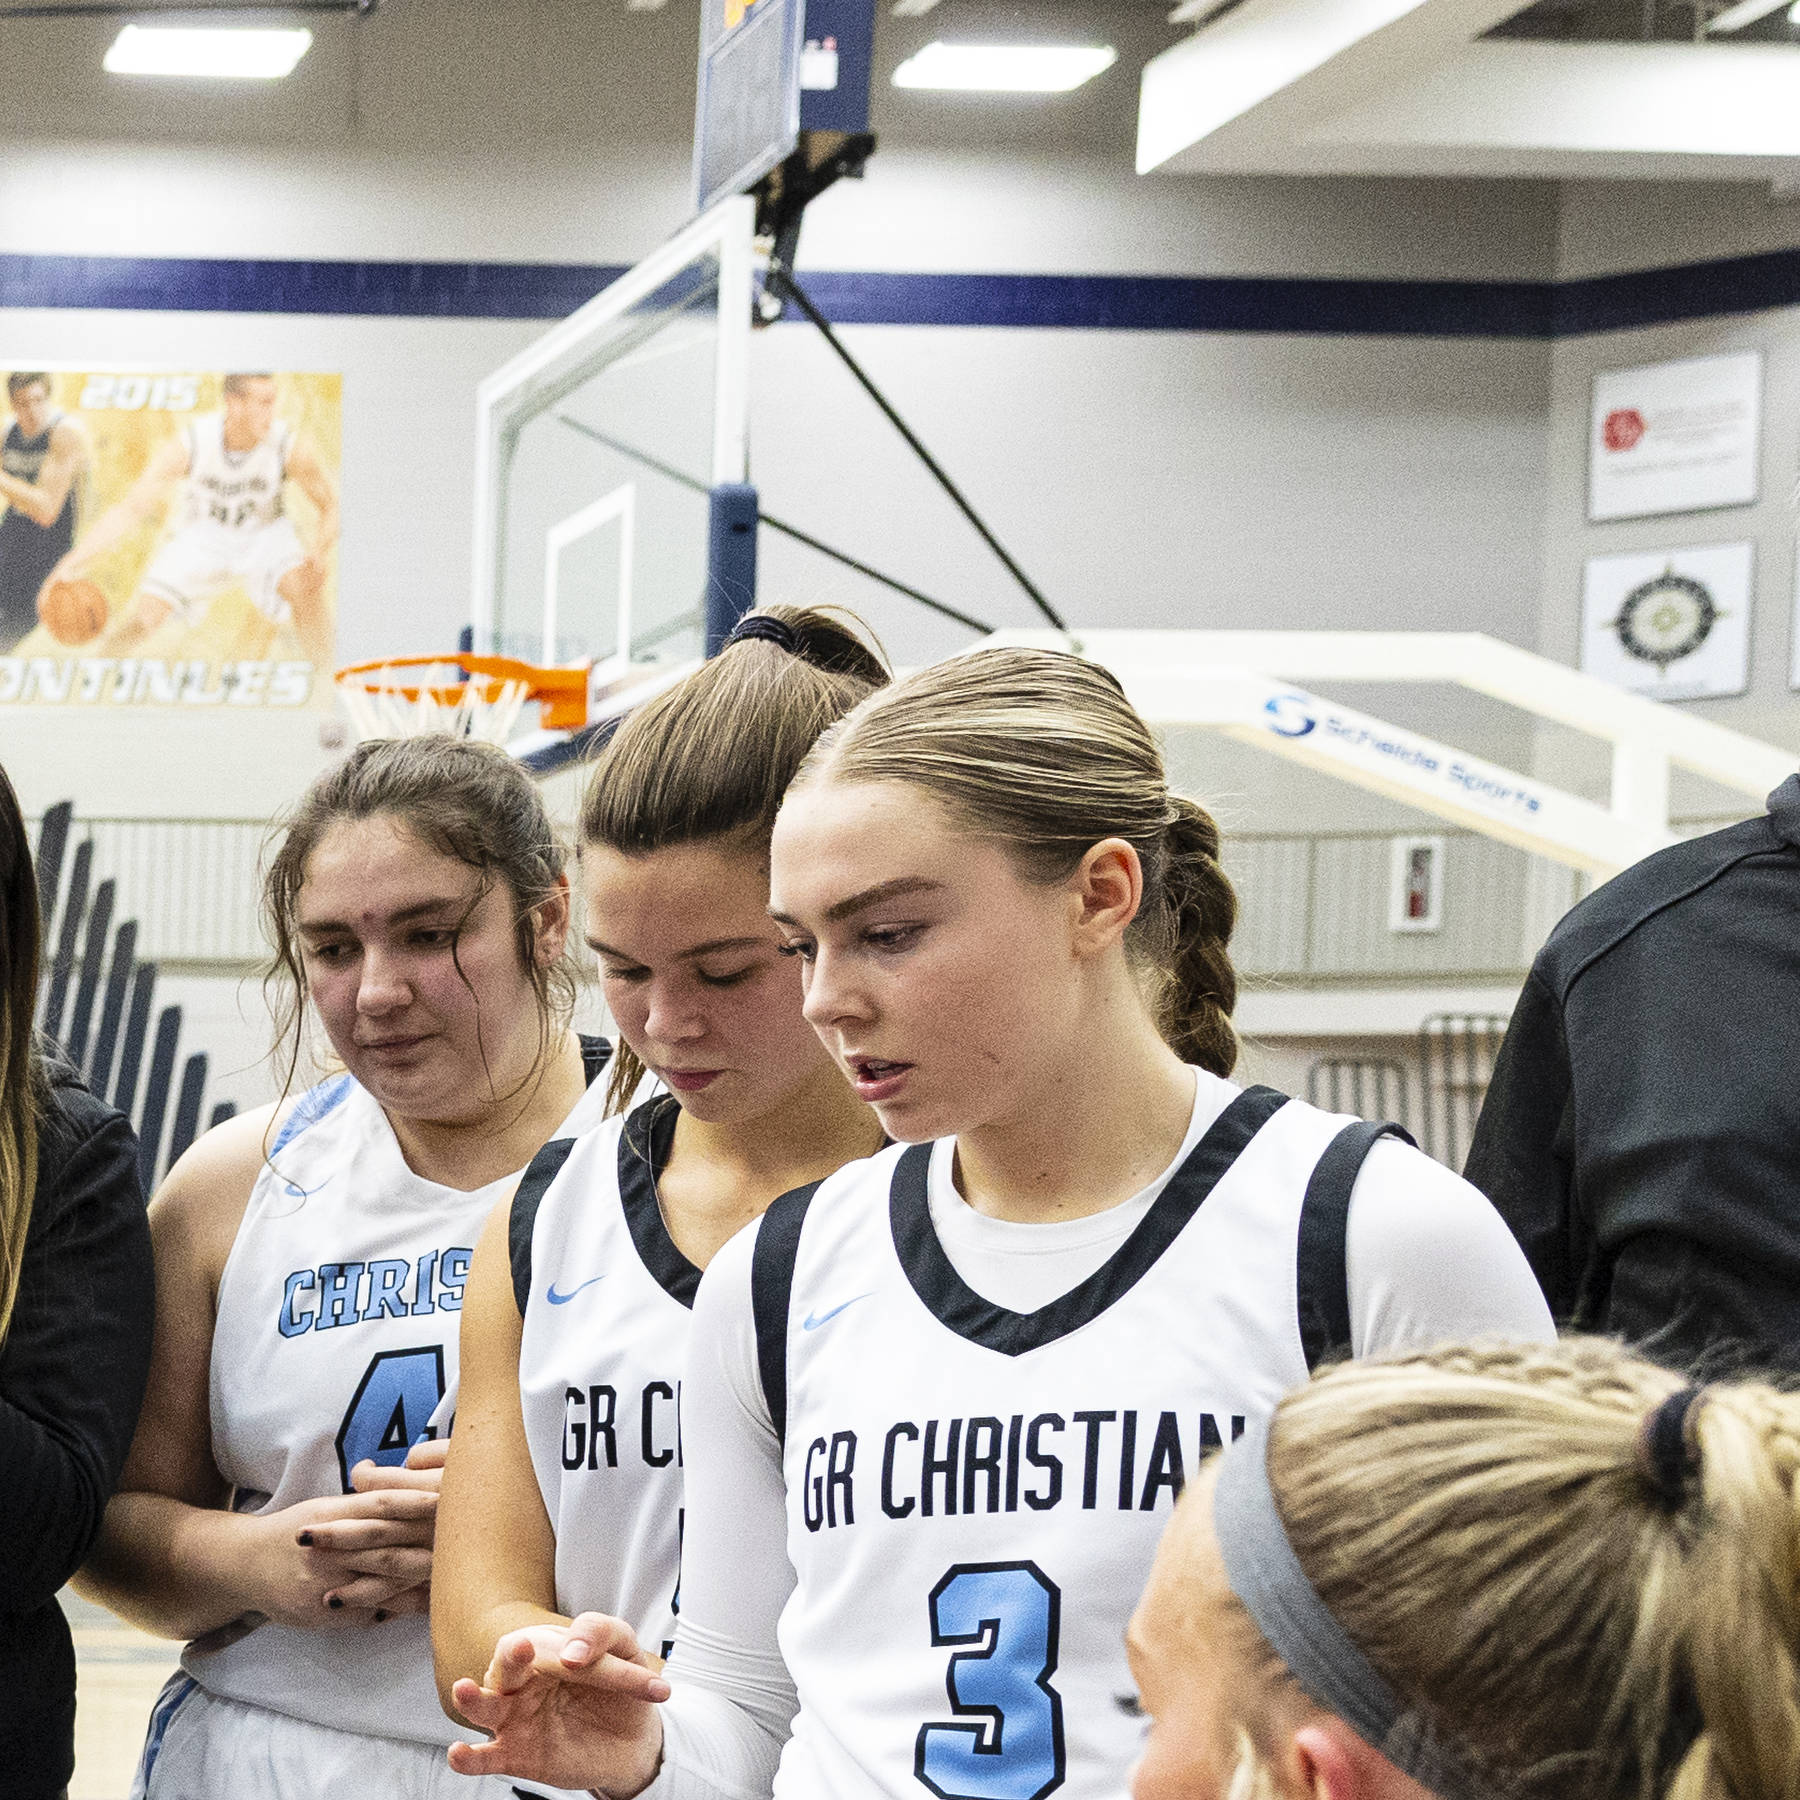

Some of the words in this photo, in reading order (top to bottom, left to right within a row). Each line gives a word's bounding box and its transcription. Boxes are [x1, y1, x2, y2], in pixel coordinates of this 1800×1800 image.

[80, 373, 200, 411] 2015
[1448, 764, 1542, 813] Sports
[562, 1385, 619, 1471] GR
[803, 1429, 858, 1533] GR
